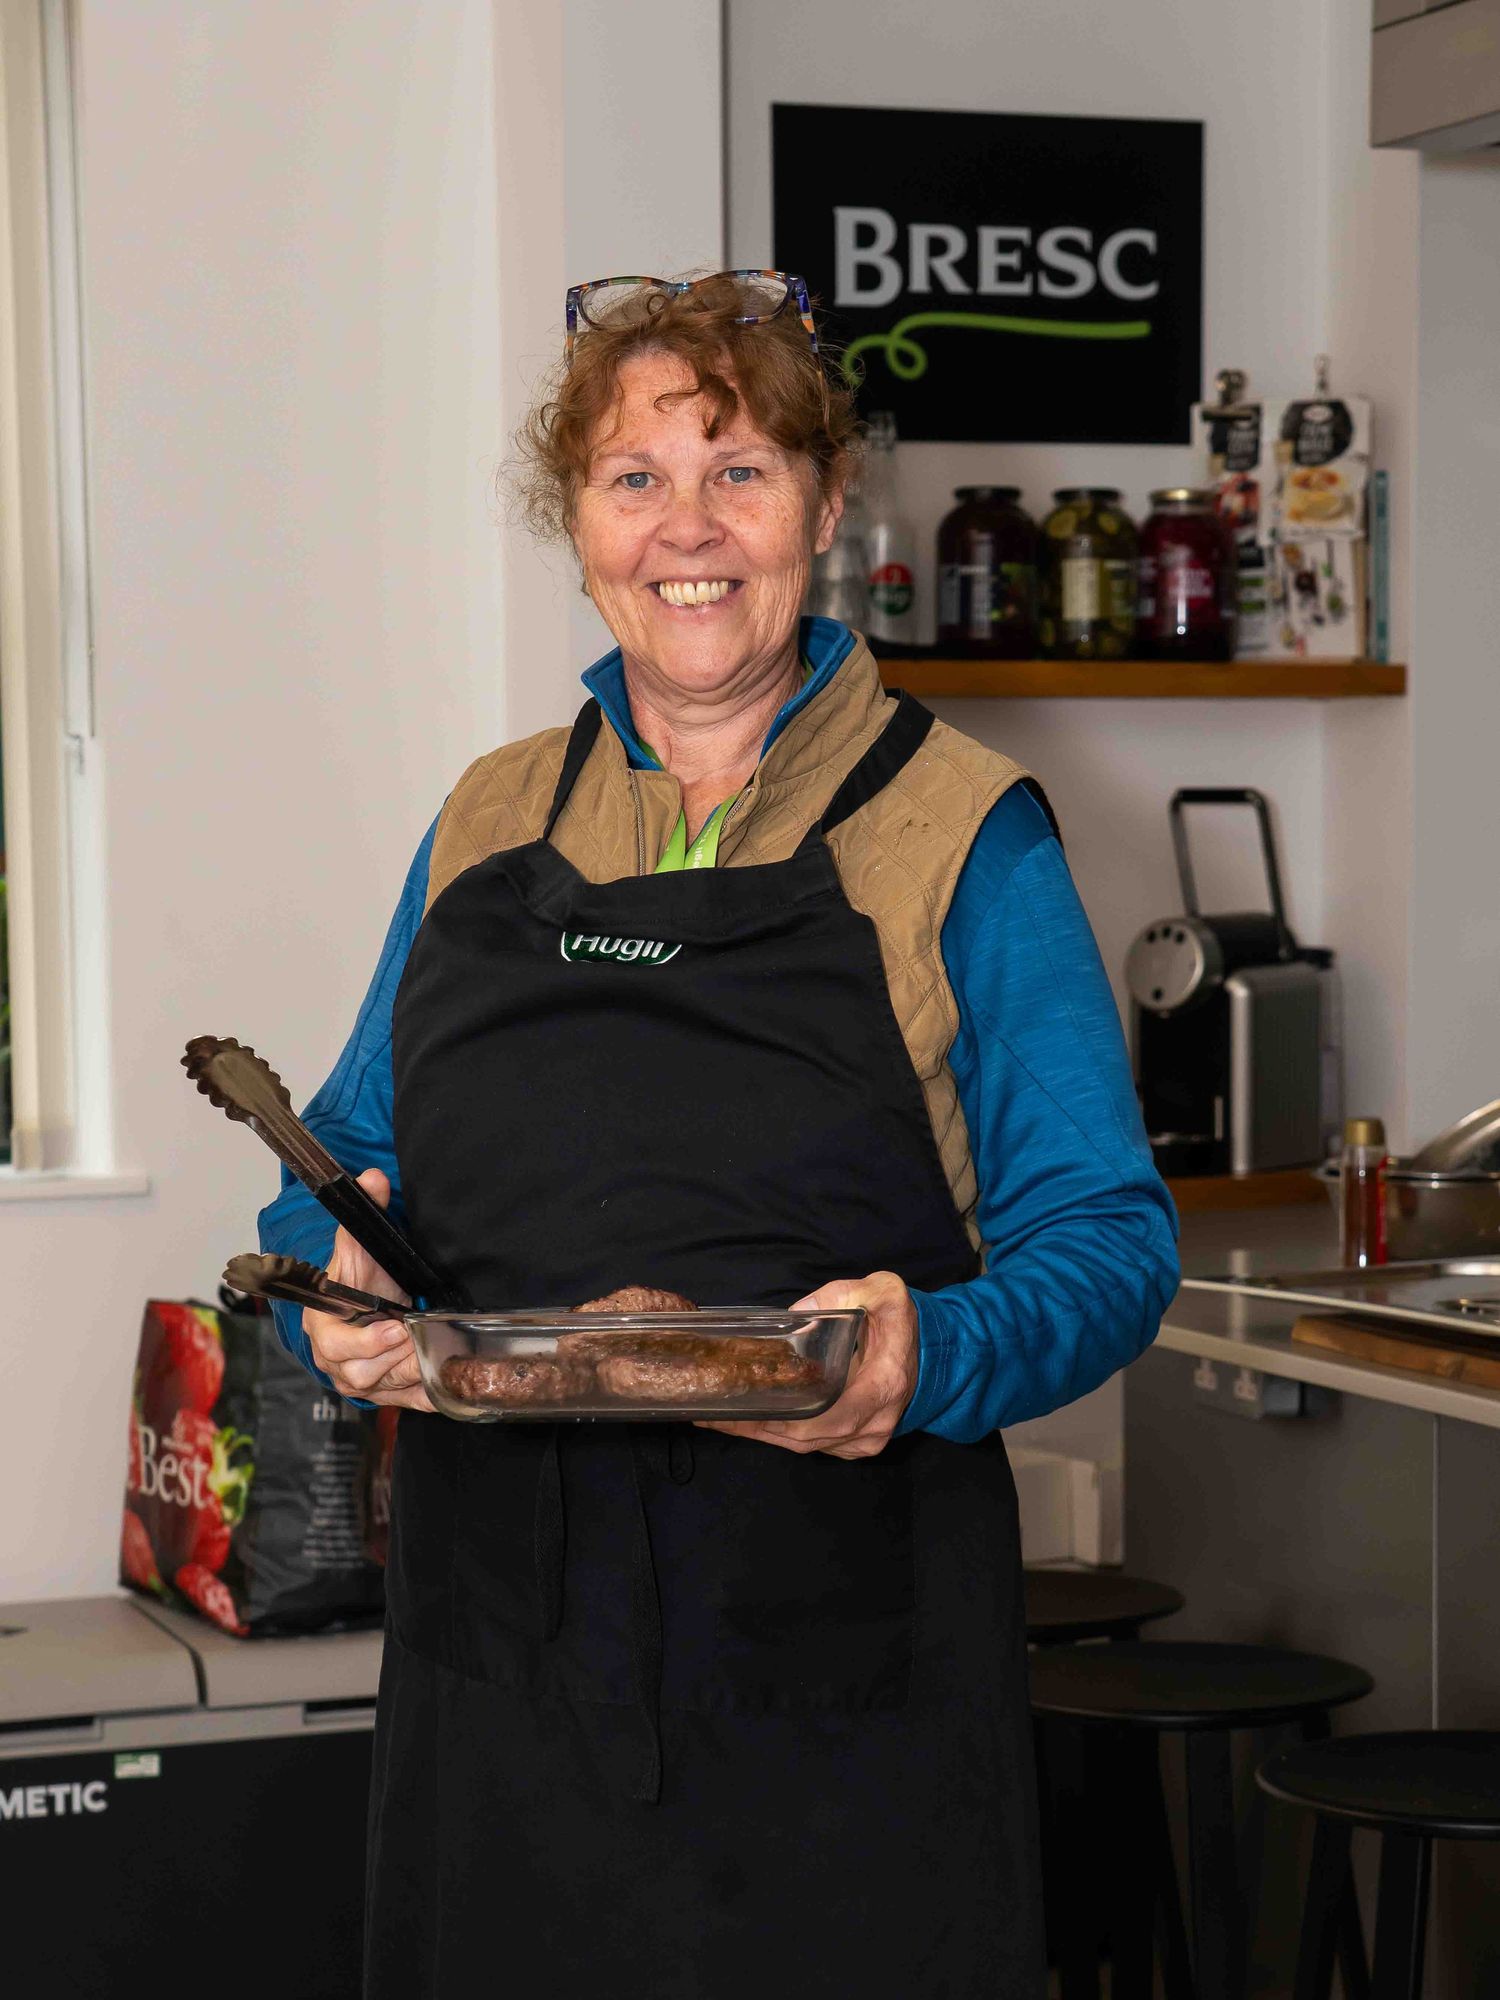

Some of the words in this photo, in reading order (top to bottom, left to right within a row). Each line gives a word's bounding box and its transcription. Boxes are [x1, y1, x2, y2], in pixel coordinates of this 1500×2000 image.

[833, 206, 1159, 308] BRESC
[139, 1424, 208, 1510] Best
[0, 1780, 107, 1820] METIC
